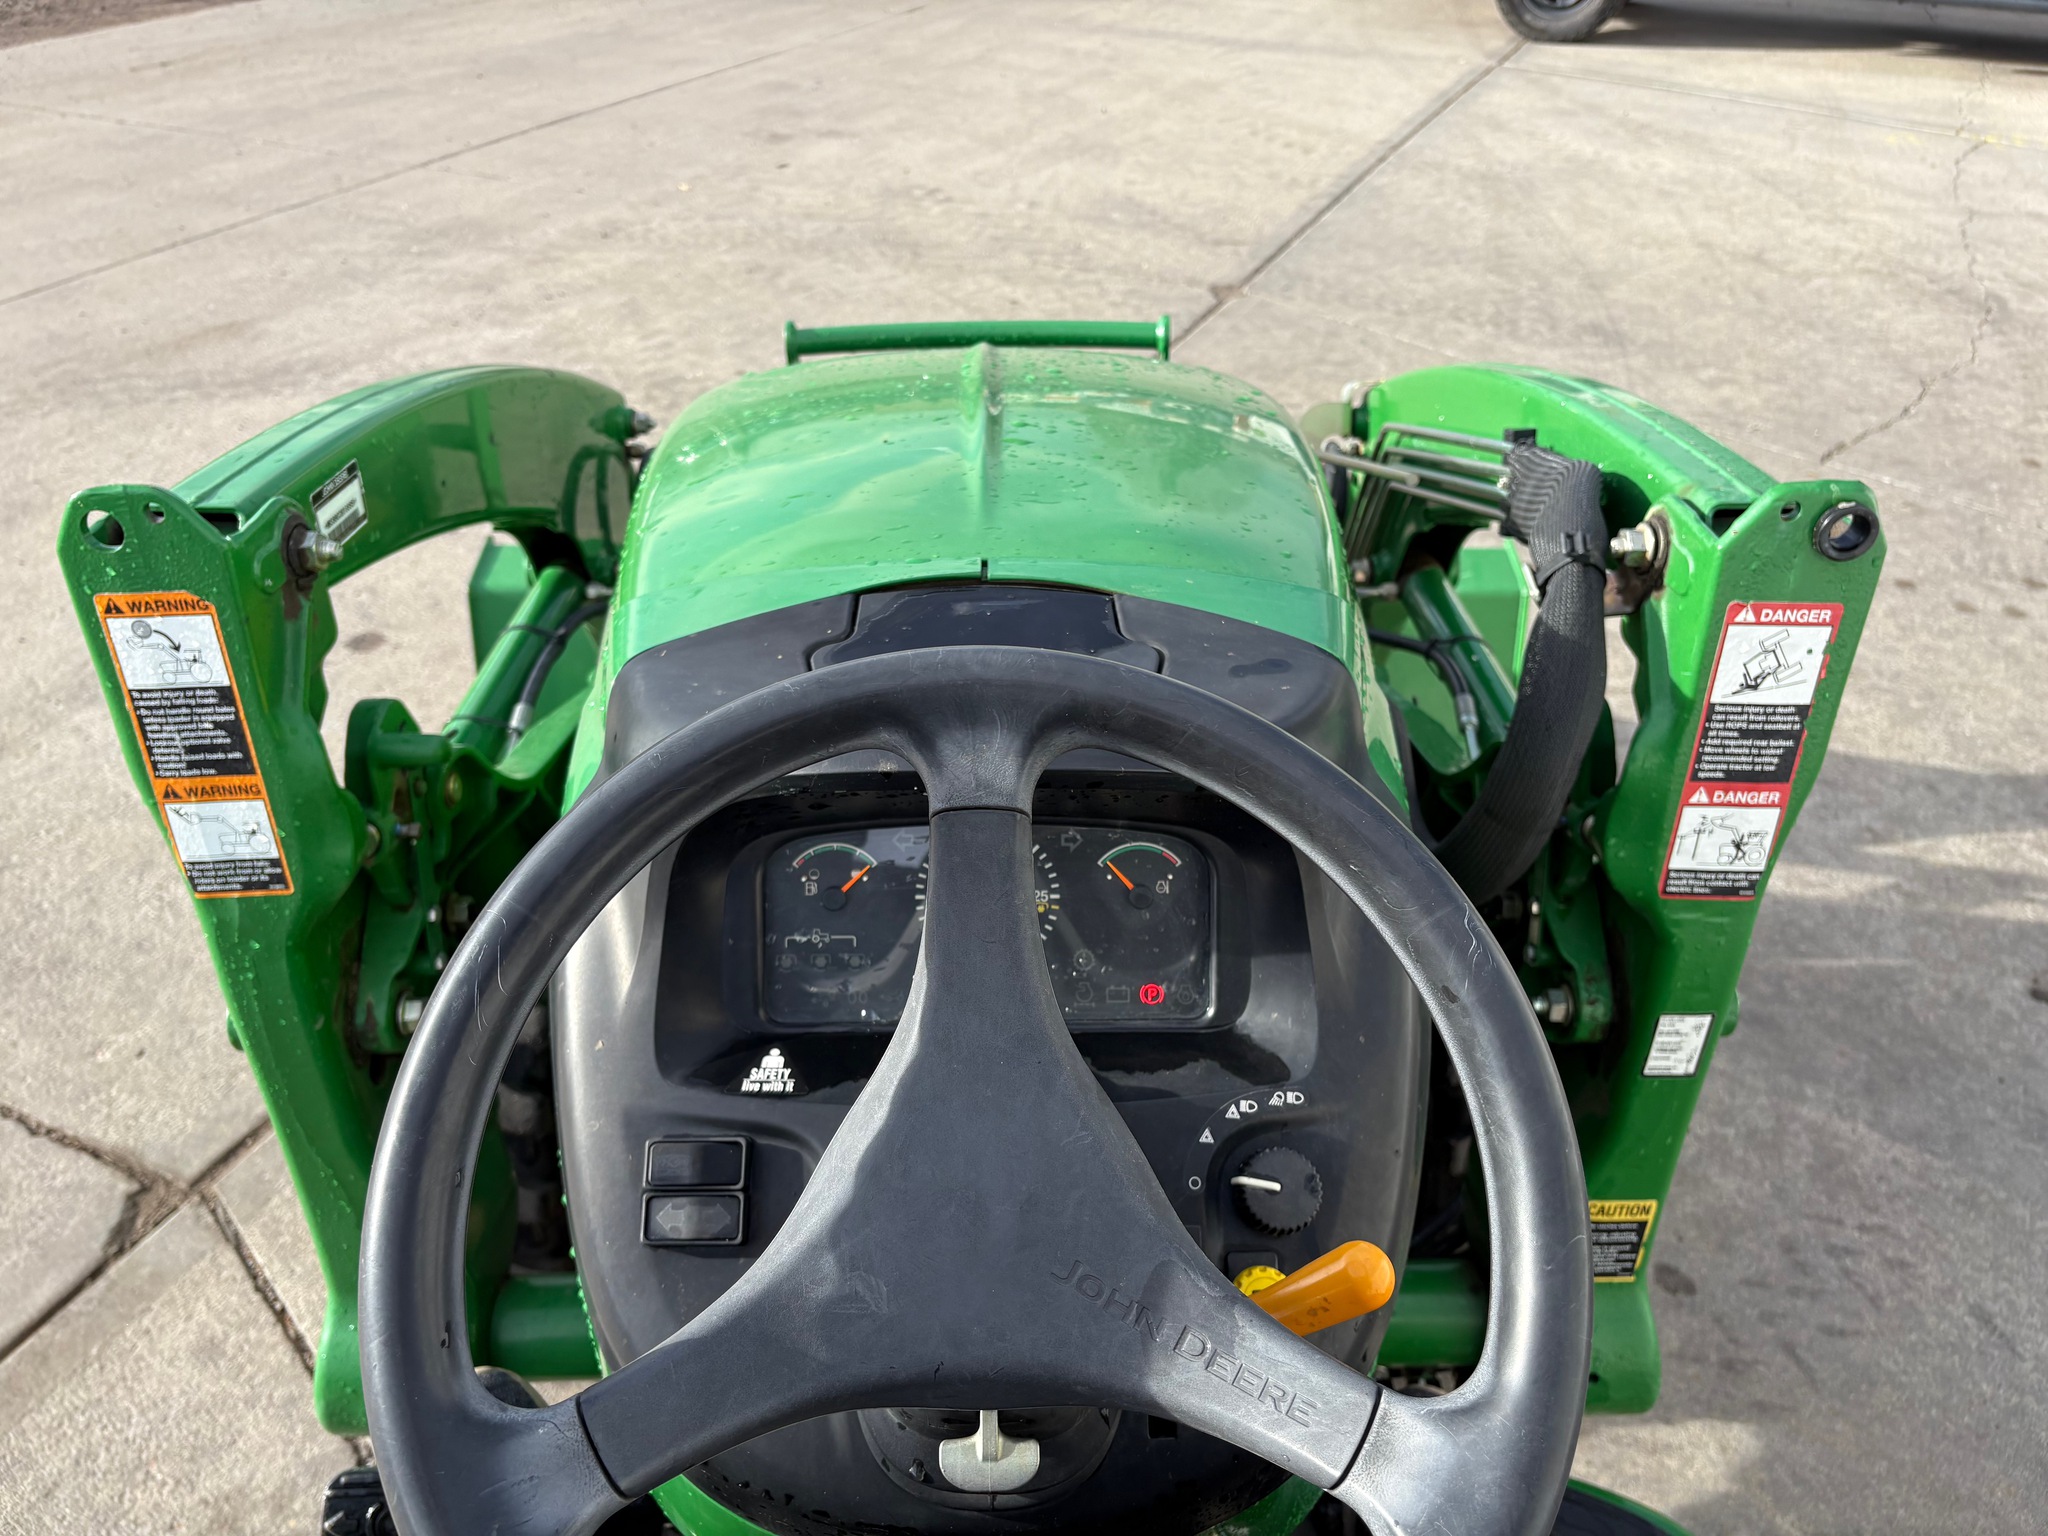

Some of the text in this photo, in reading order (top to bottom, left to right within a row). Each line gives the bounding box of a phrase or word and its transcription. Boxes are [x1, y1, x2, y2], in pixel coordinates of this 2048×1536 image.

[126, 598, 209, 613] WARNING
[1760, 609, 1831, 623] DANGER
[184, 784, 261, 798] WARNING
[1713, 790, 1780, 804] DANGER
[1034, 890, 1049, 902] 25
[749, 1067, 792, 1080] SAFETY
[741, 1078, 795, 1092] live with it
[1050, 1260, 1321, 1428] JOHN DEERE
